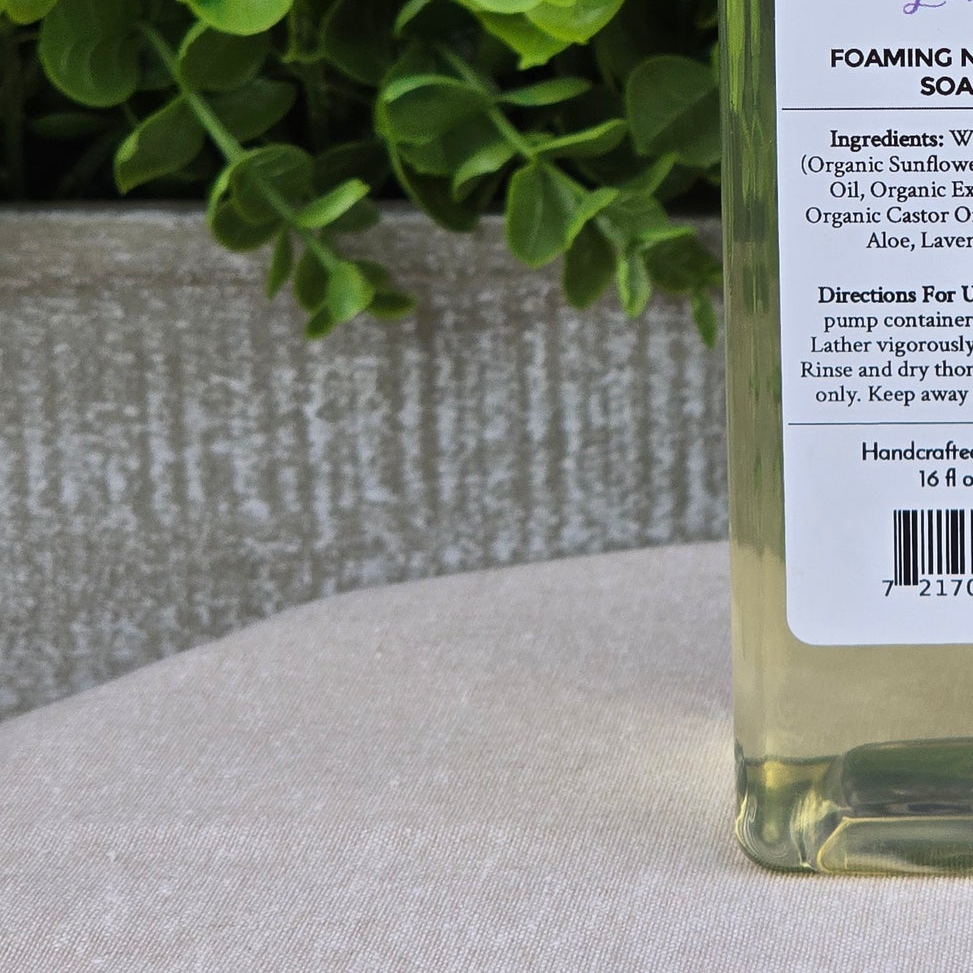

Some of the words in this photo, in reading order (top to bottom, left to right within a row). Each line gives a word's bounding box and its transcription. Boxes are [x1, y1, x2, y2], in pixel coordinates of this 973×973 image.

[831, 47, 952, 68] FOAMING
[830, 129, 944, 152] Ingredients:
[801, 154, 884, 176] (Organic
[830, 180, 866, 201] Oil,
[870, 180, 946, 201] Organic
[806, 205, 881, 227] Organic
[886, 205, 949, 227] Castor
[866, 230, 915, 252] Aloe,
[818, 286, 917, 306] Directions
[921, 285, 956, 306] For
[824, 315, 879, 331] pump
[810, 335, 872, 355] Lather
[800, 361, 853, 378] Rinse
[858, 361, 892, 378] and
[898, 360, 930, 381] dry
[816, 385, 861, 407] only.
[868, 385, 915, 407] Keep
[921, 387, 969, 406] away
[919, 470, 939, 487] 16
[945, 467, 958, 487] fl
[882, 579, 893, 597] 7
